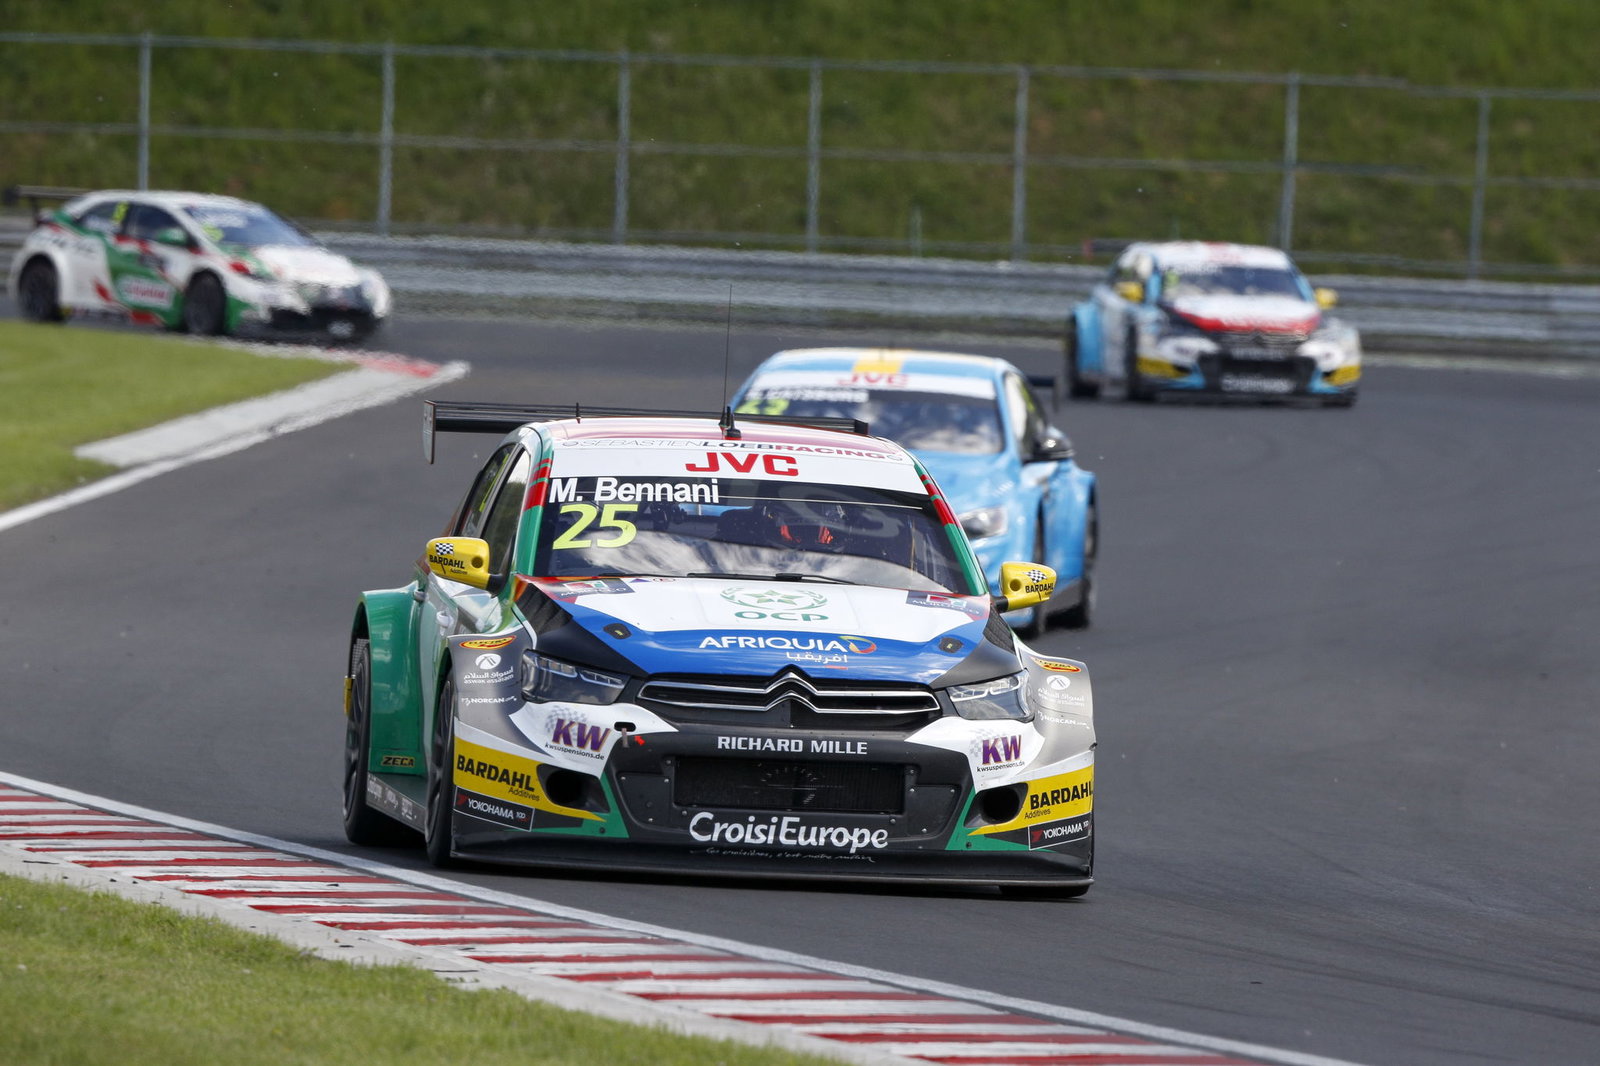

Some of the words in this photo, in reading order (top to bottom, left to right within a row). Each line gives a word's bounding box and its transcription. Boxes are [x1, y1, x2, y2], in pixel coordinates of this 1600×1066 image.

[685, 452, 799, 477] JVC
[549, 477, 583, 503] M.
[594, 477, 720, 503] Bennani
[552, 503, 639, 550] 25
[429, 554, 465, 569] BARDAHL
[734, 610, 829, 622] OCP
[698, 636, 848, 653] AFRIQUIA
[552, 717, 612, 752] KW
[544, 741, 605, 760] kwsuspensions.de
[717, 736, 803, 752] RICHARD
[811, 740, 868, 755] MILLE
[982, 734, 1022, 766] KW
[456, 754, 535, 793] BARDAHL
[508, 787, 540, 802] Additives
[468, 798, 514, 819] YOKOHAMA
[1024, 808, 1051, 820] Additives
[689, 811, 889, 853] CroisiEurope
[1043, 823, 1083, 839] YOKOHAMA
